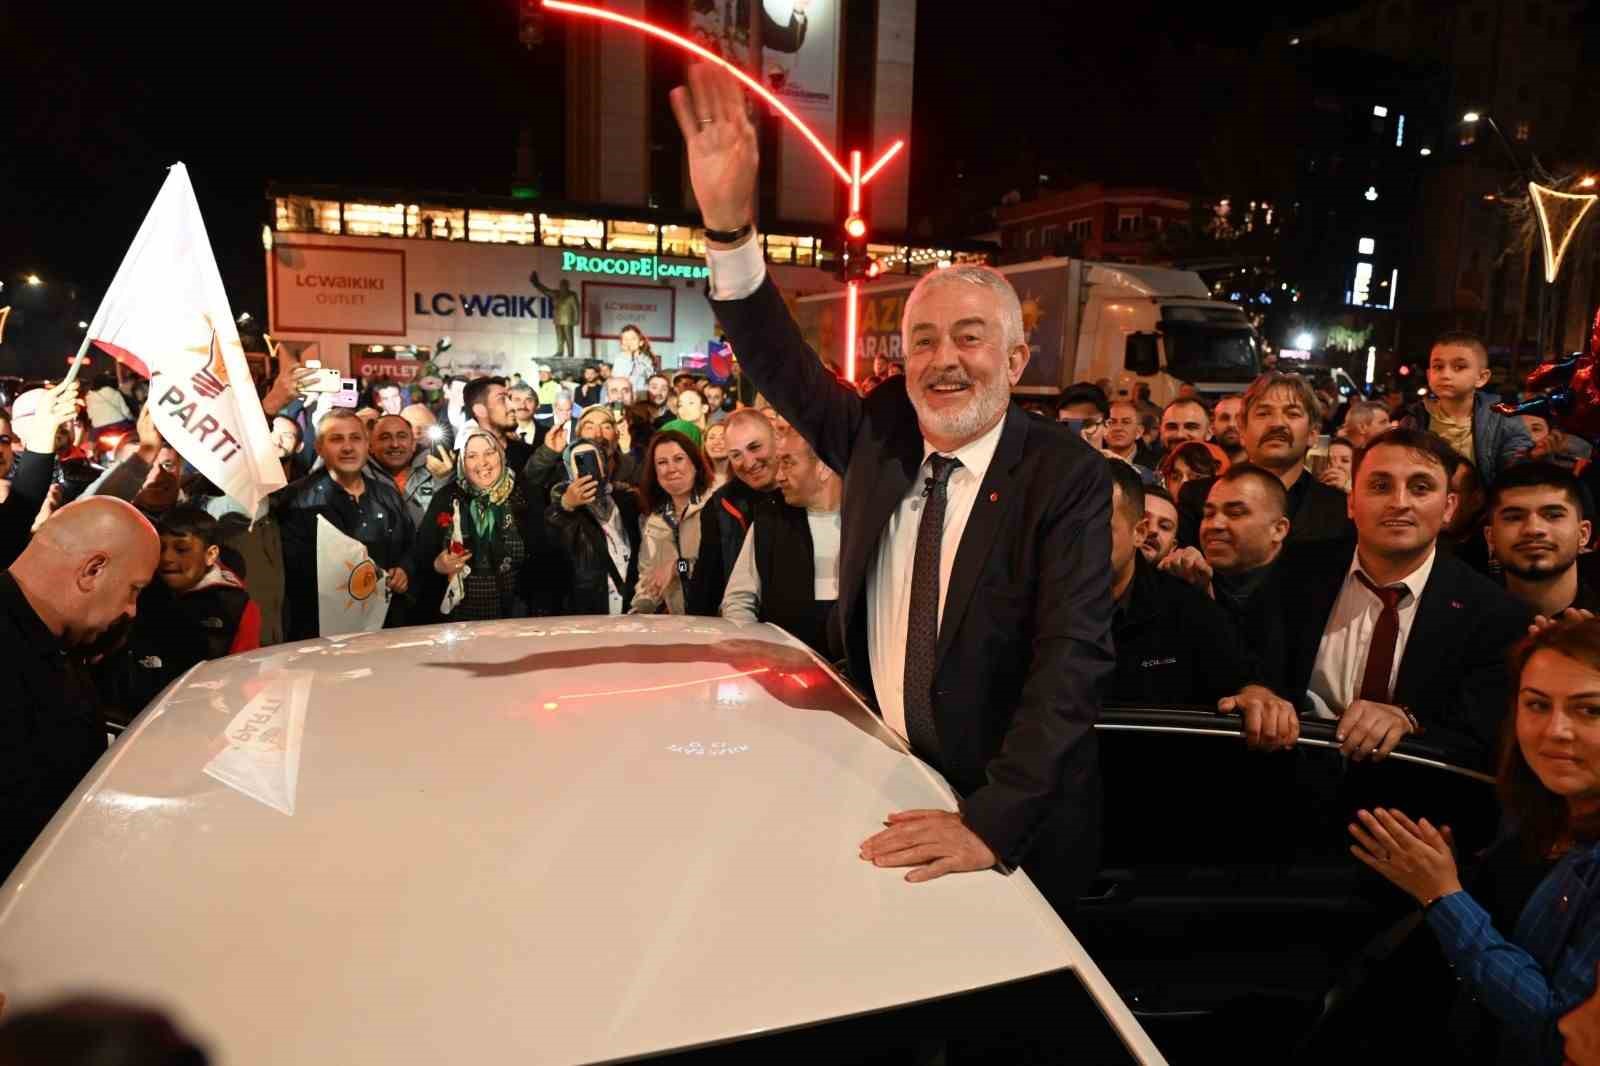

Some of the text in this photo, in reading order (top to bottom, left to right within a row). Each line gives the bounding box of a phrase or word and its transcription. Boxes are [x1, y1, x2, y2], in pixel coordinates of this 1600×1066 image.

[562, 251, 652, 276] PROCOPE
[315, 293, 368, 305] OUTLET
[361, 363, 421, 378] OUTLET
